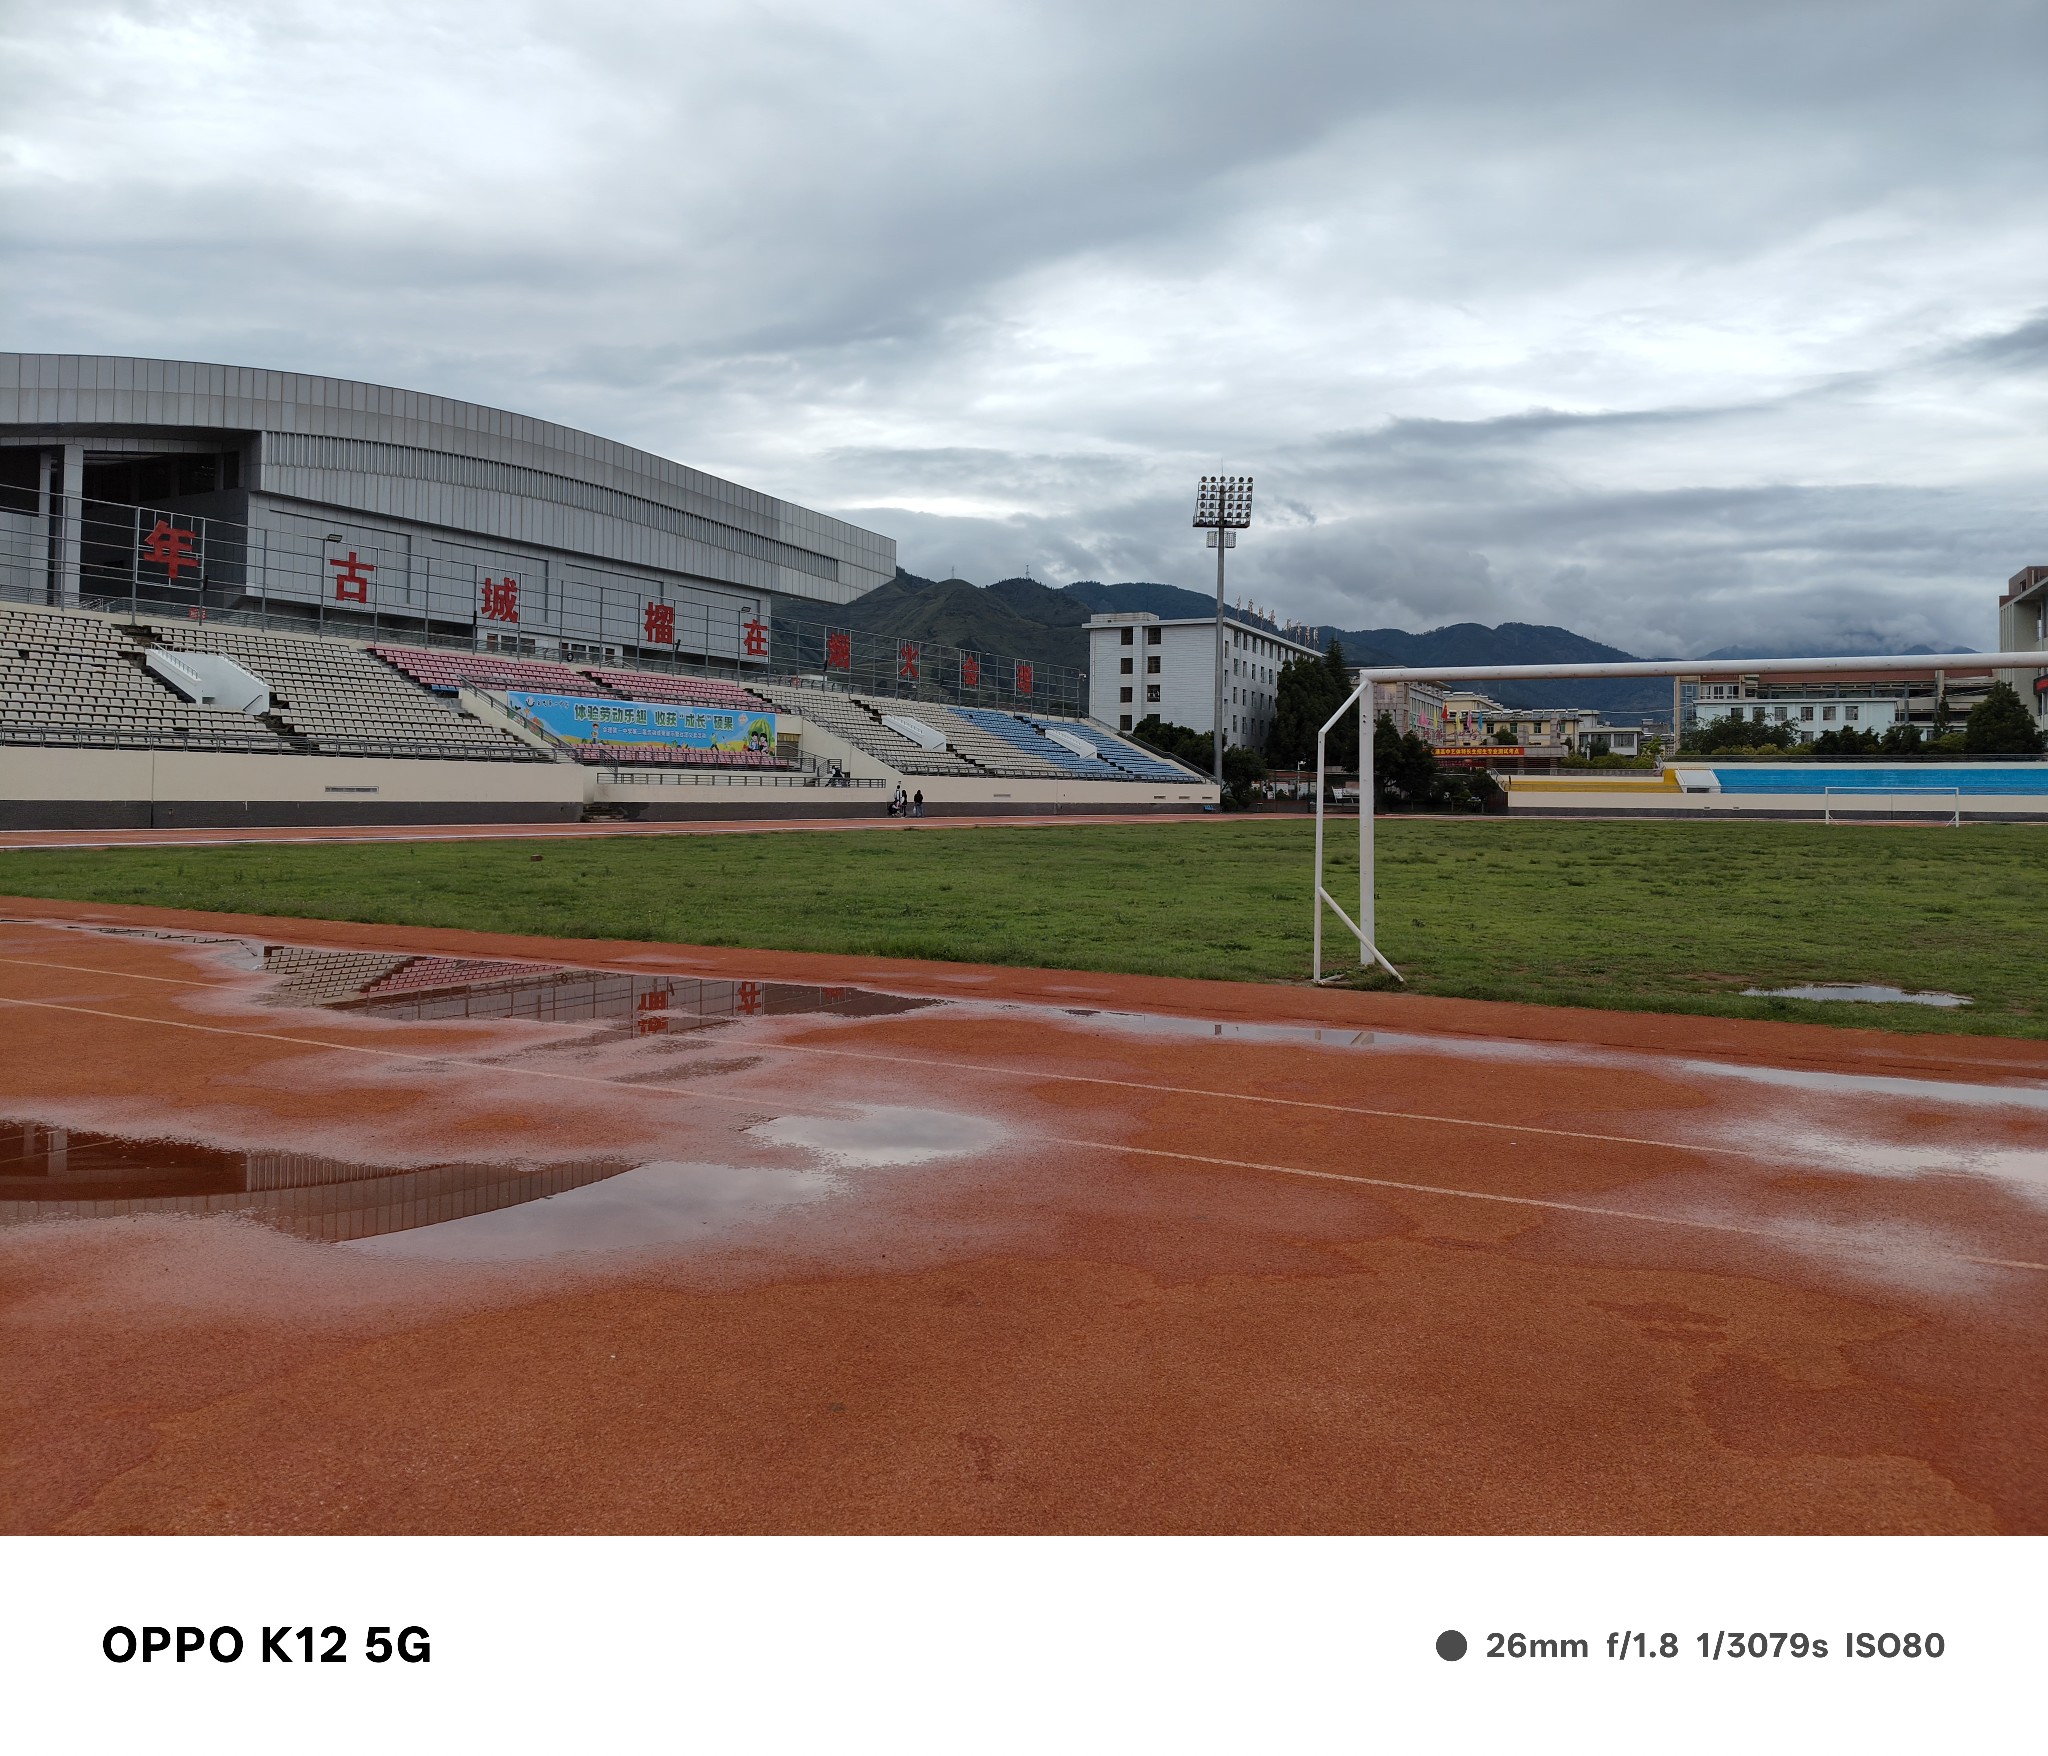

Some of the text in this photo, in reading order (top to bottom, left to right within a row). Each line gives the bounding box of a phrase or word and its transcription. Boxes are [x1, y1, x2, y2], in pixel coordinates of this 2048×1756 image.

[574, 703, 648, 725] 体验劳动乐趣
